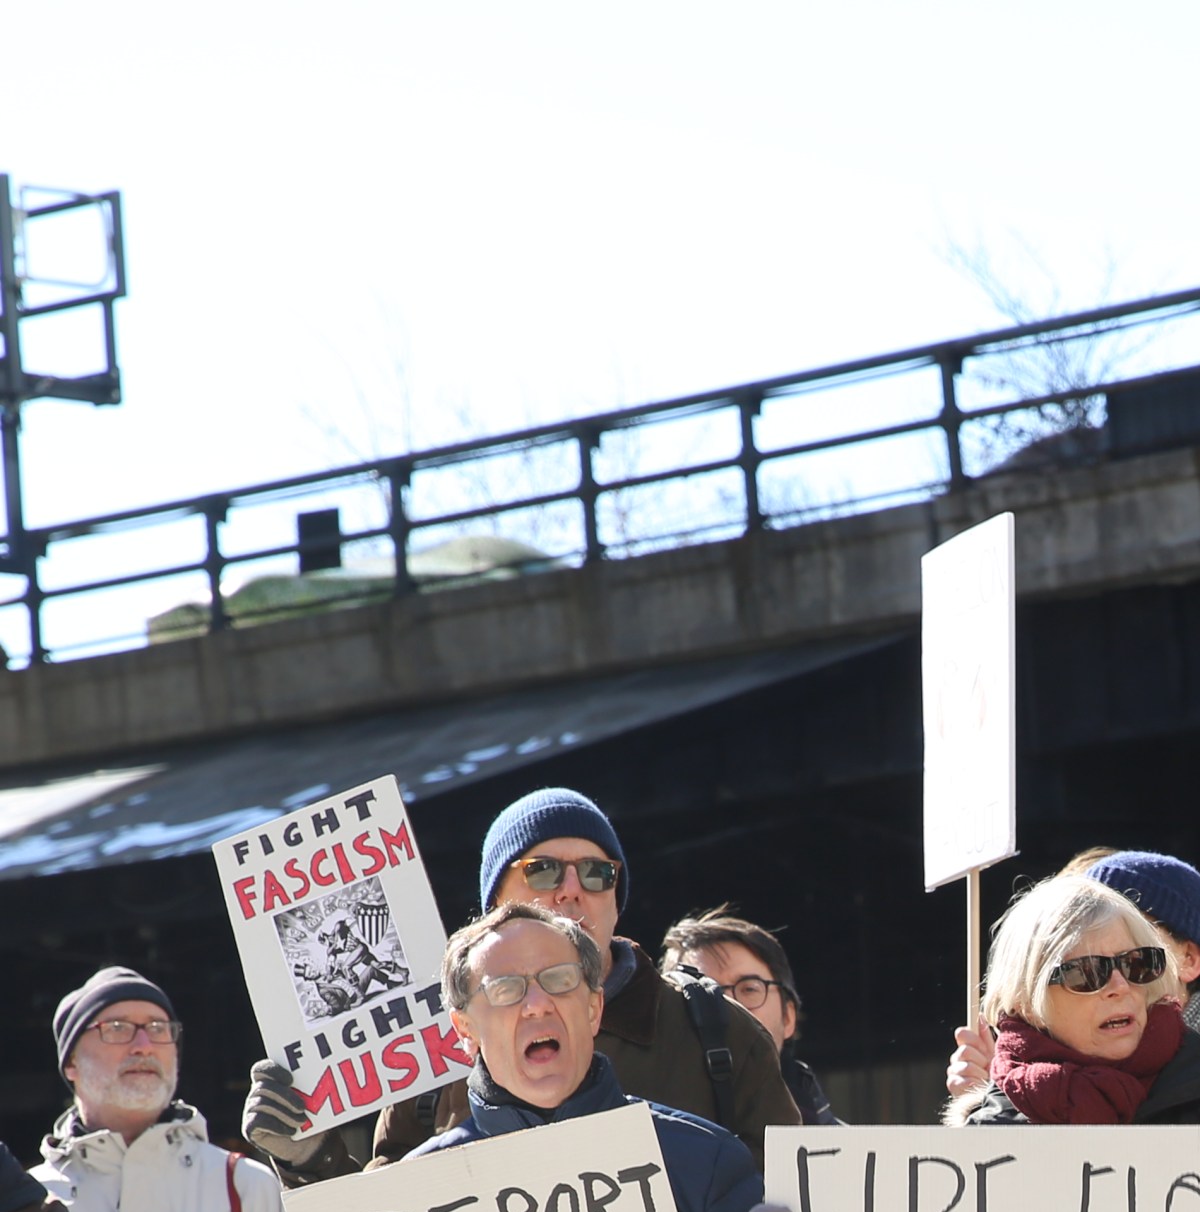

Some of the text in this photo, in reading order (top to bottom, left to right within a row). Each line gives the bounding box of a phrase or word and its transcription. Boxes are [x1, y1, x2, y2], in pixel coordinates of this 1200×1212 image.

[233, 790, 377, 866] FIGHT
[233, 818, 416, 920] FASCISM
[284, 982, 446, 1071] FIGHT
[291, 1023, 475, 1132] MUSK
